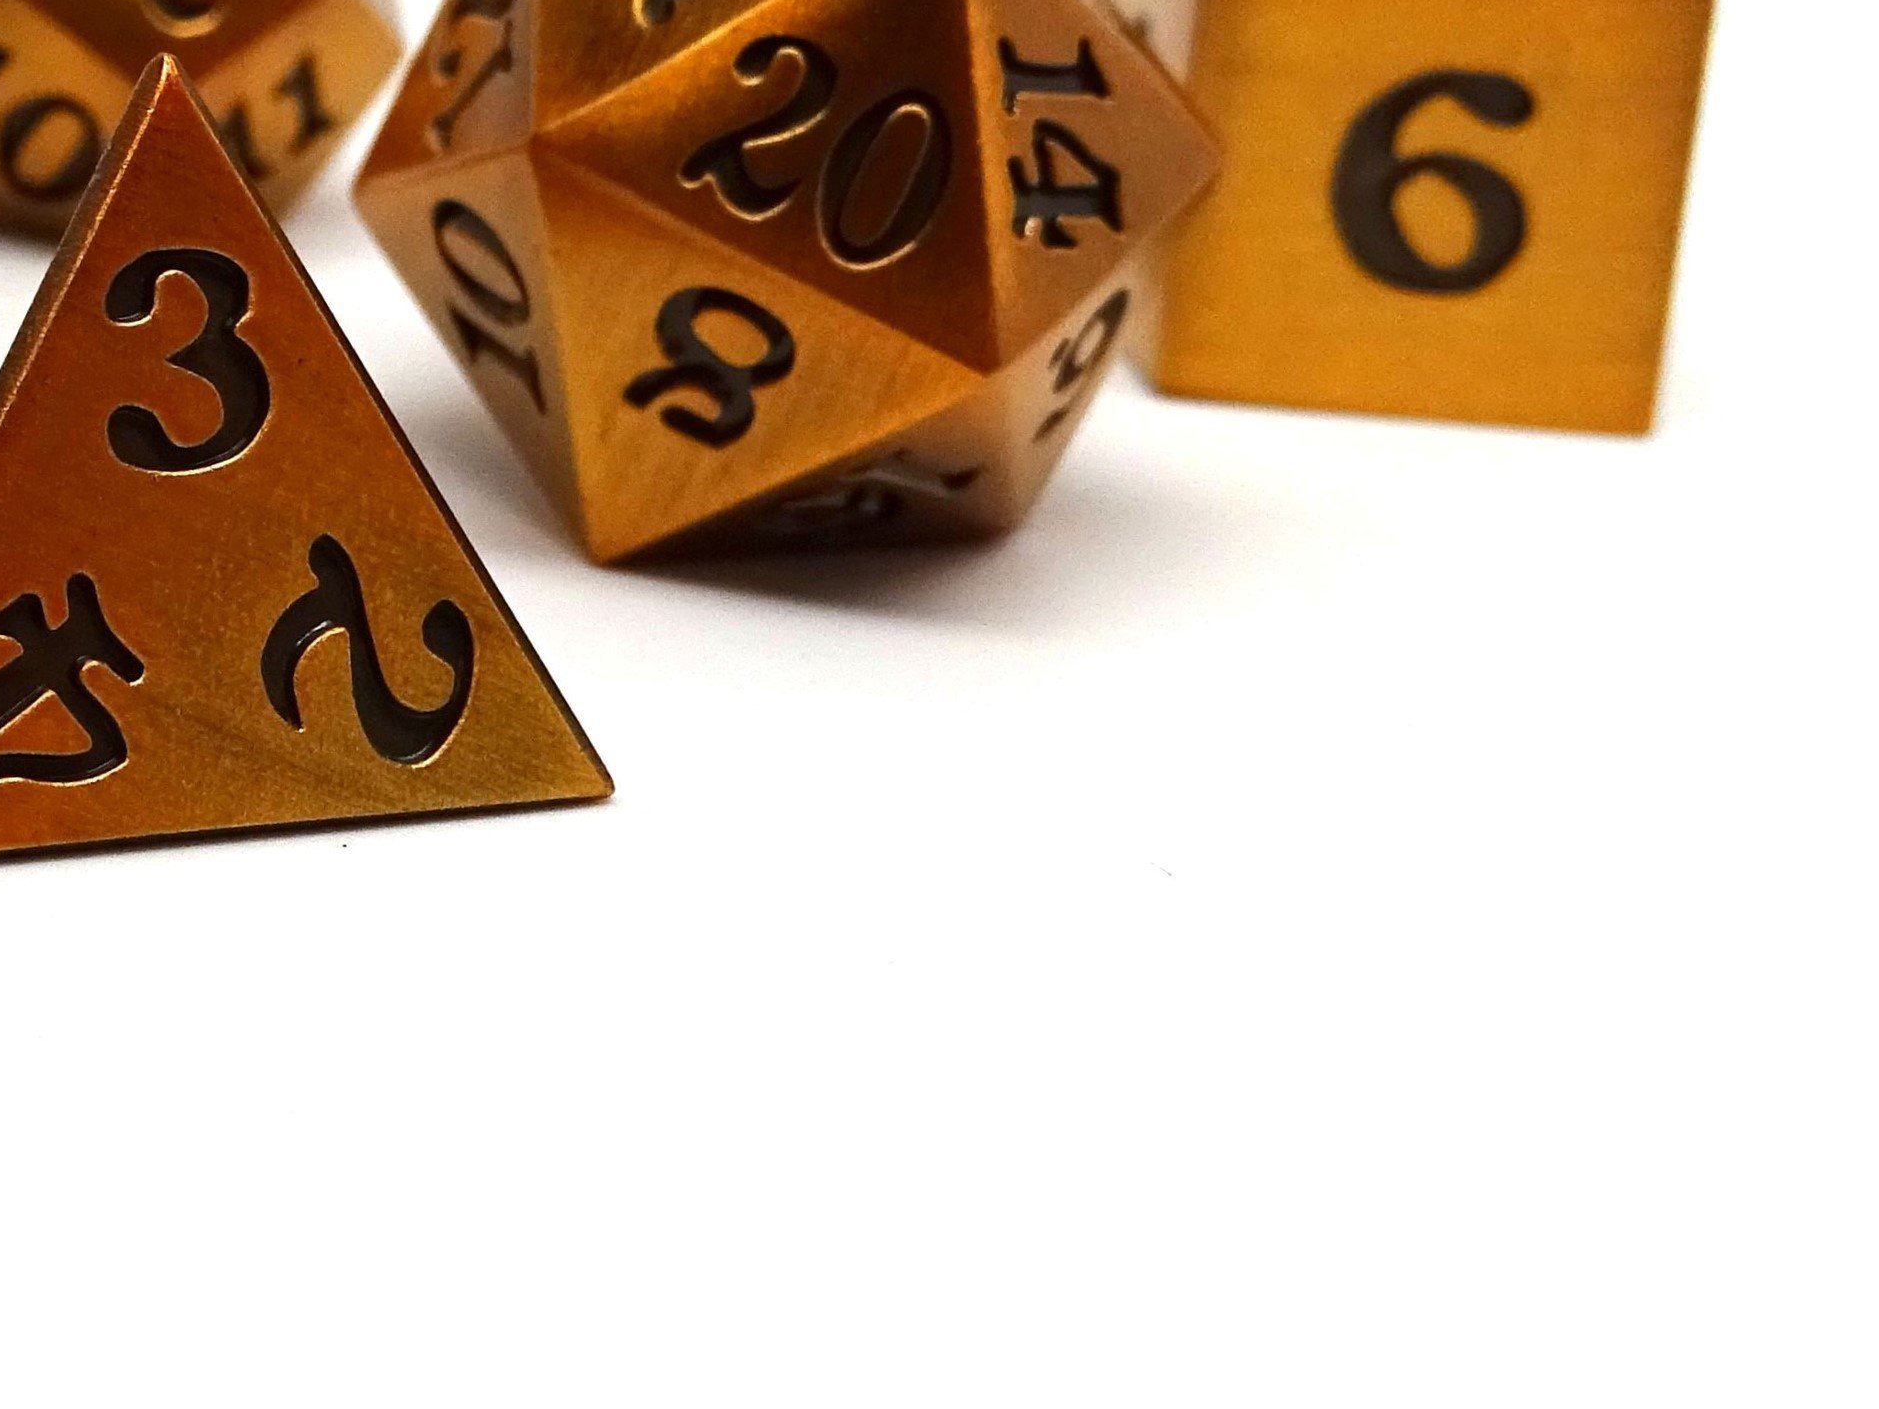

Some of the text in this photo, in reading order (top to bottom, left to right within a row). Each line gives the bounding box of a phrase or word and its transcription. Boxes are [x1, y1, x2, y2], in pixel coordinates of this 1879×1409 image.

[677, 33, 953, 273] 20
[999, 35, 1124, 251] 14
[1329, 68, 1536, 298] 6
[105, 248, 272, 477] 3
[431, 199, 546, 416] 10
[623, 286, 796, 450] 8
[260, 533, 476, 769] 2
